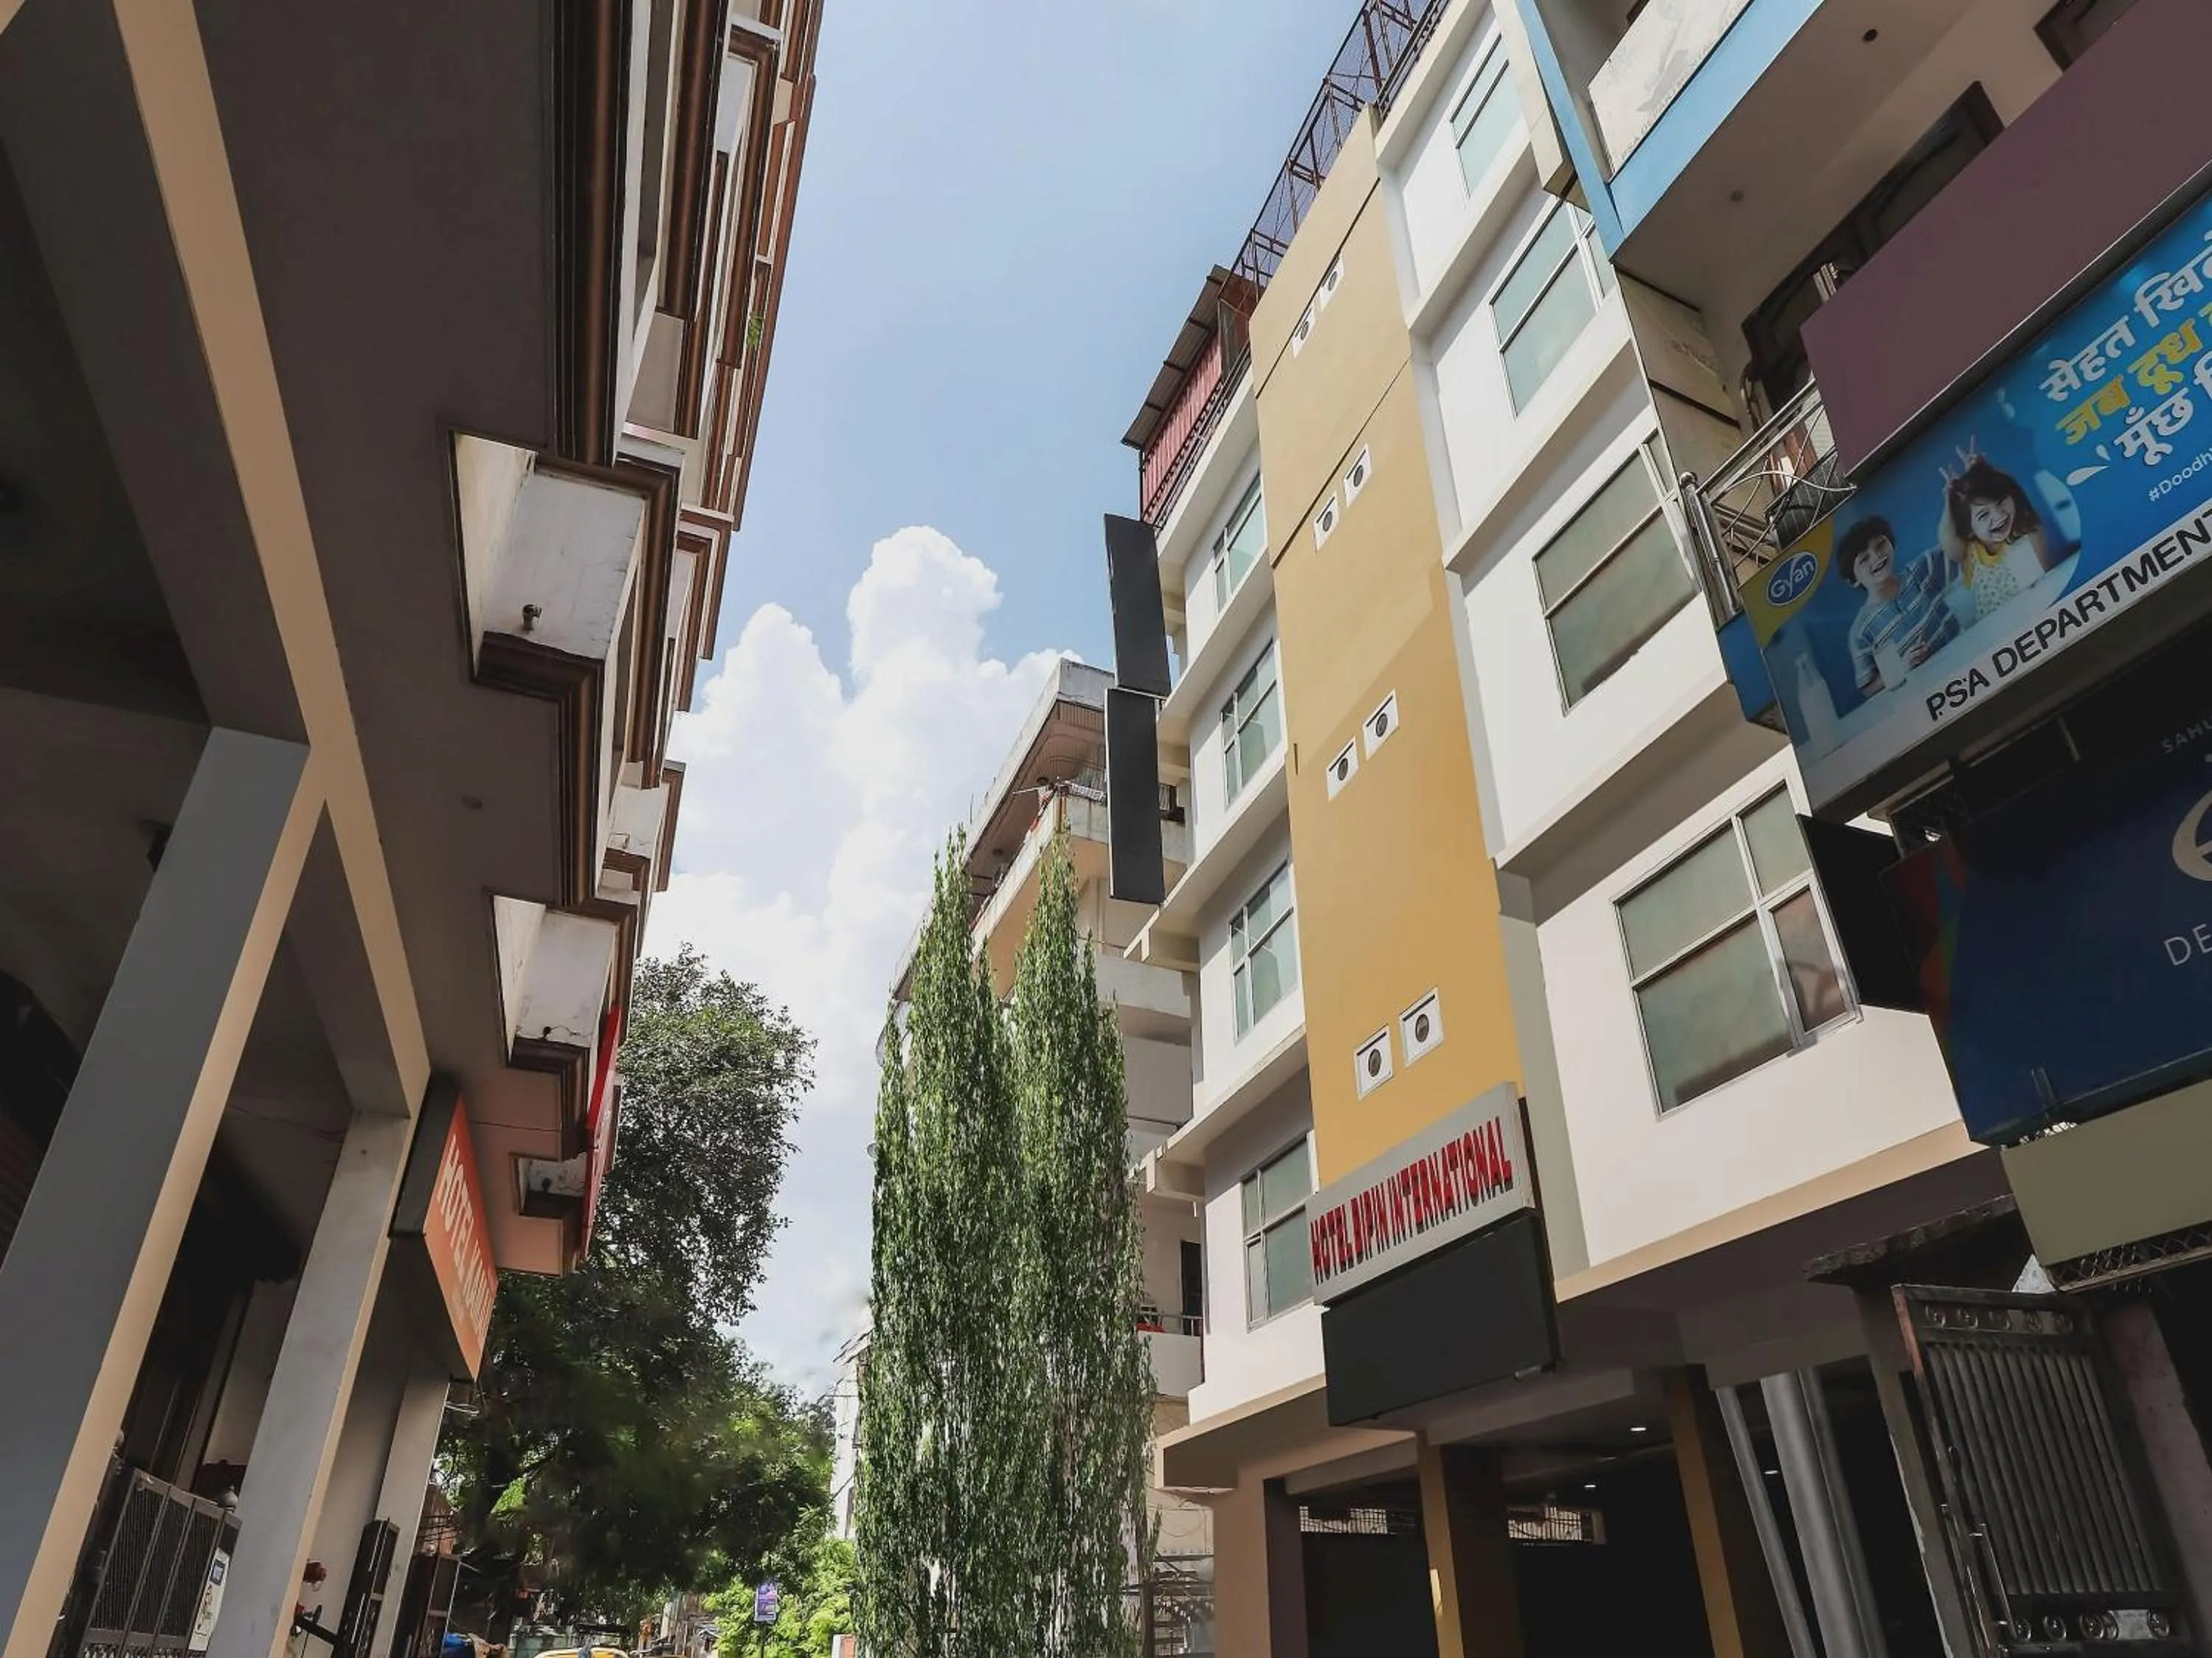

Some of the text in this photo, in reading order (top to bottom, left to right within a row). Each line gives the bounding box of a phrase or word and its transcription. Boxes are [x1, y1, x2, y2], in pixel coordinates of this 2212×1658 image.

[2038, 315, 2136, 401] सेहत
[2055, 374, 2131, 445] जब
[2126, 318, 2203, 395] दूध
[2149, 448, 2212, 502] #Doodh
[1770, 553, 1815, 599] Gyan
[437, 1132, 474, 1283] HOTEL
[1311, 1204, 1354, 1286] HOTEL
[1388, 1116, 1514, 1246] INTERNATIONAL
